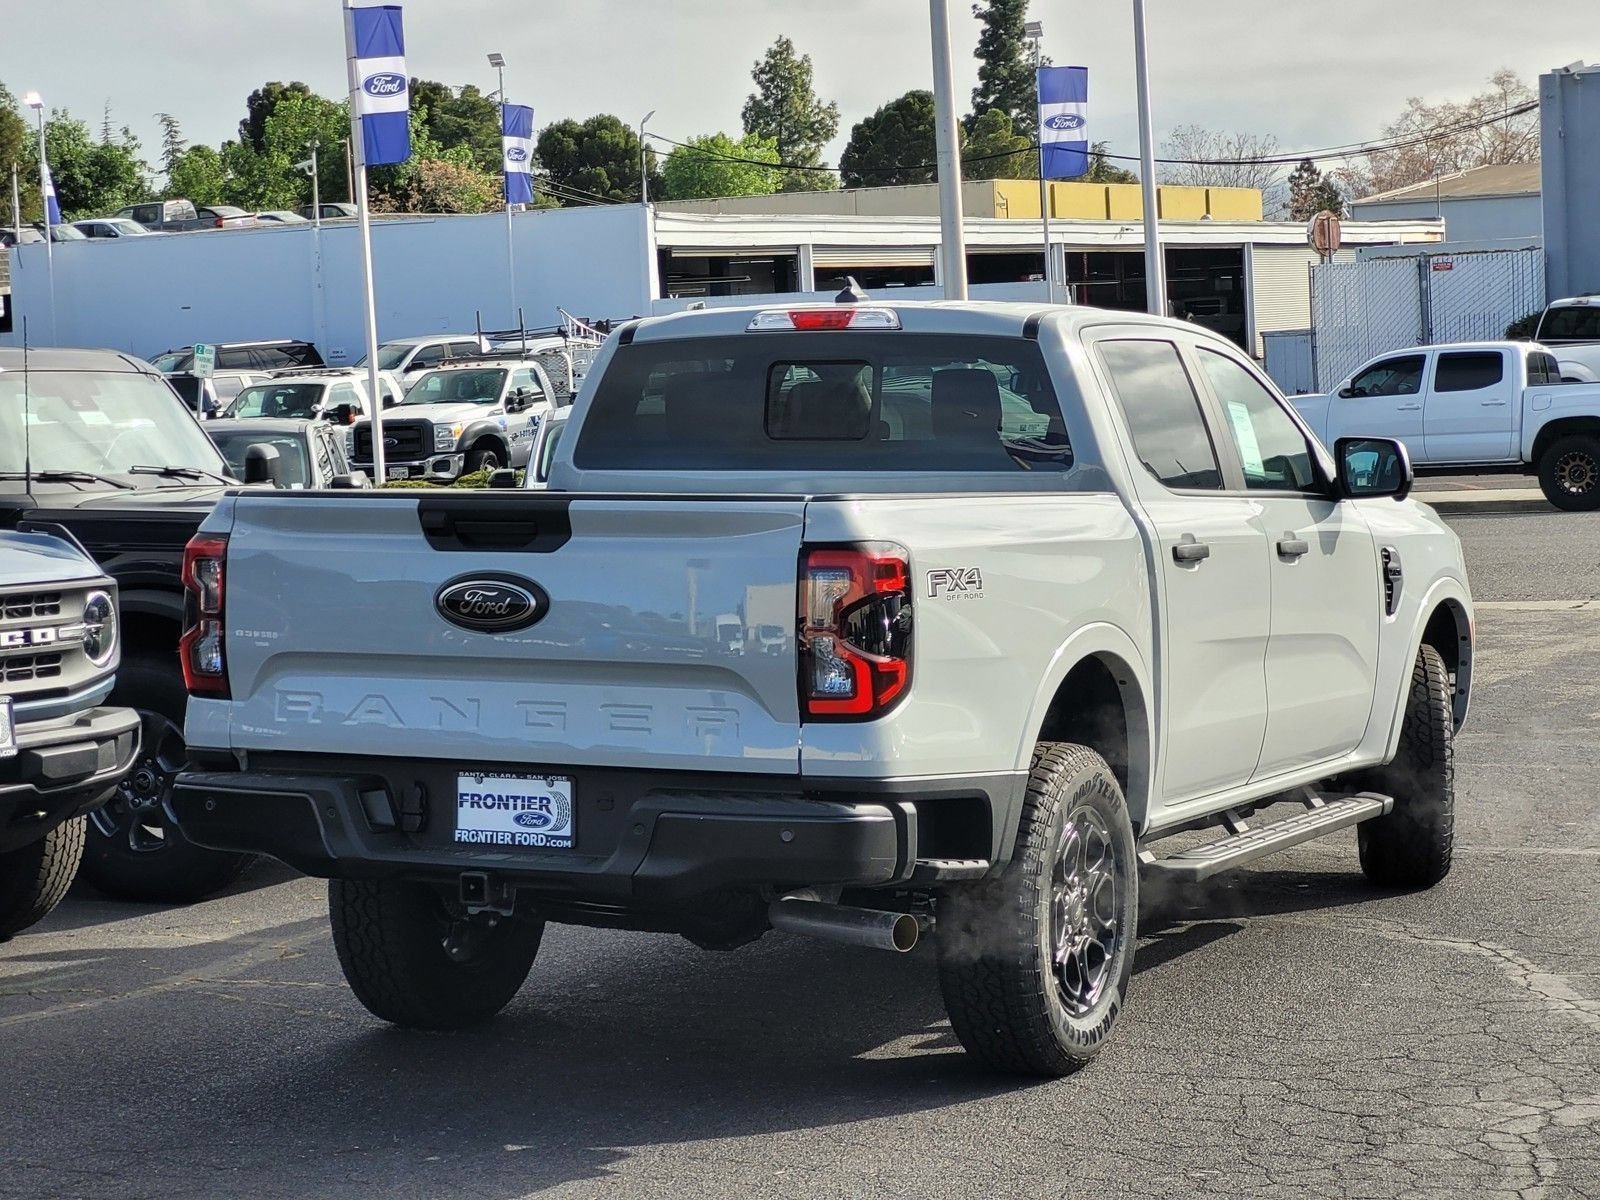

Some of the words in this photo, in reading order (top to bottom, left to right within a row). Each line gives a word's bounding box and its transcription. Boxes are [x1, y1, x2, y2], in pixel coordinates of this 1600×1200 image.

[371, 76, 401, 93] Ford
[1052, 116, 1078, 129] Ford
[509, 148, 526, 161] Ford
[926, 567, 983, 598] FX4
[459, 589, 512, 615] Ford
[946, 593, 962, 601] OFF
[964, 592, 984, 600] ROAD
[274, 689, 740, 739] RANGER
[458, 792, 554, 817] FRONTIER
[519, 814, 545, 826] Ford
[455, 829, 513, 845] FRONTIER
[1062, 1001, 1119, 1047] WRANGLER
